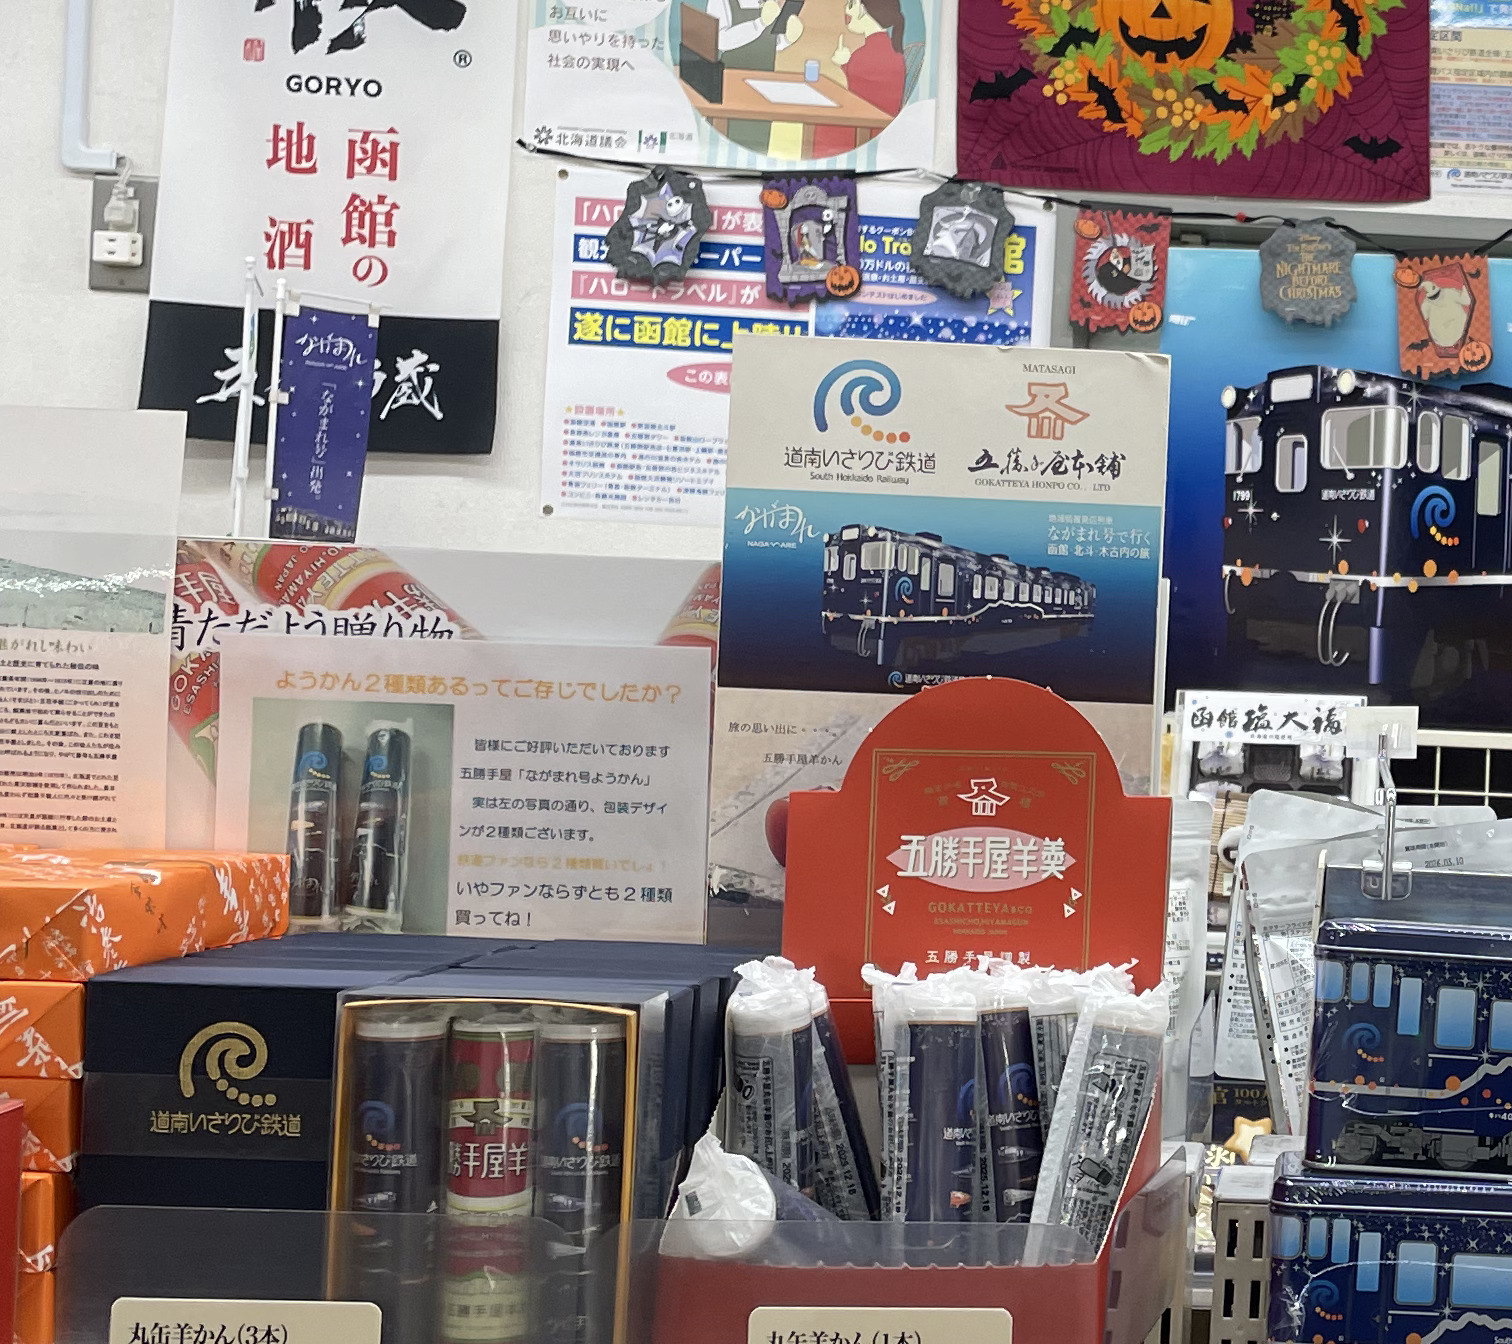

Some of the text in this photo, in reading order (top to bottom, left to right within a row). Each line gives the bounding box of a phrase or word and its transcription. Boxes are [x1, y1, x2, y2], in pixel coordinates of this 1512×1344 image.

[549, 4, 608, 23] お互いに
[548, 29, 665, 49] 思いやりを持った
[547, 53, 635, 73] 社会の実現へ
[285, 75, 382, 98] GORYO
[556, 132, 628, 150] 北海道議会
[263, 121, 318, 272] 地酒
[341, 126, 400, 287] 函館の
[1022, 363, 1077, 375] MATASAGI
[784, 446, 937, 475] 道南いさりび鉄道
[810, 472, 910, 485] South Hokkaido Railway
[974, 478, 1030, 490] GOKATTEYA
[1031, 480, 1064, 490] HONPO
[1047, 525, 1151, 545] ながまれ号で行く
[474, 739, 670, 758] 皆様にご好評いただいております
[460, 767, 650, 786] 五勝手屋「ながまれ号ようかん」
[472, 797, 667, 814] 実は左の写真の通り、包装デザイ
[897, 834, 1066, 880] 五勝手屋羊羹
[150, 1108, 302, 1138] 道南いさりび鉄道
